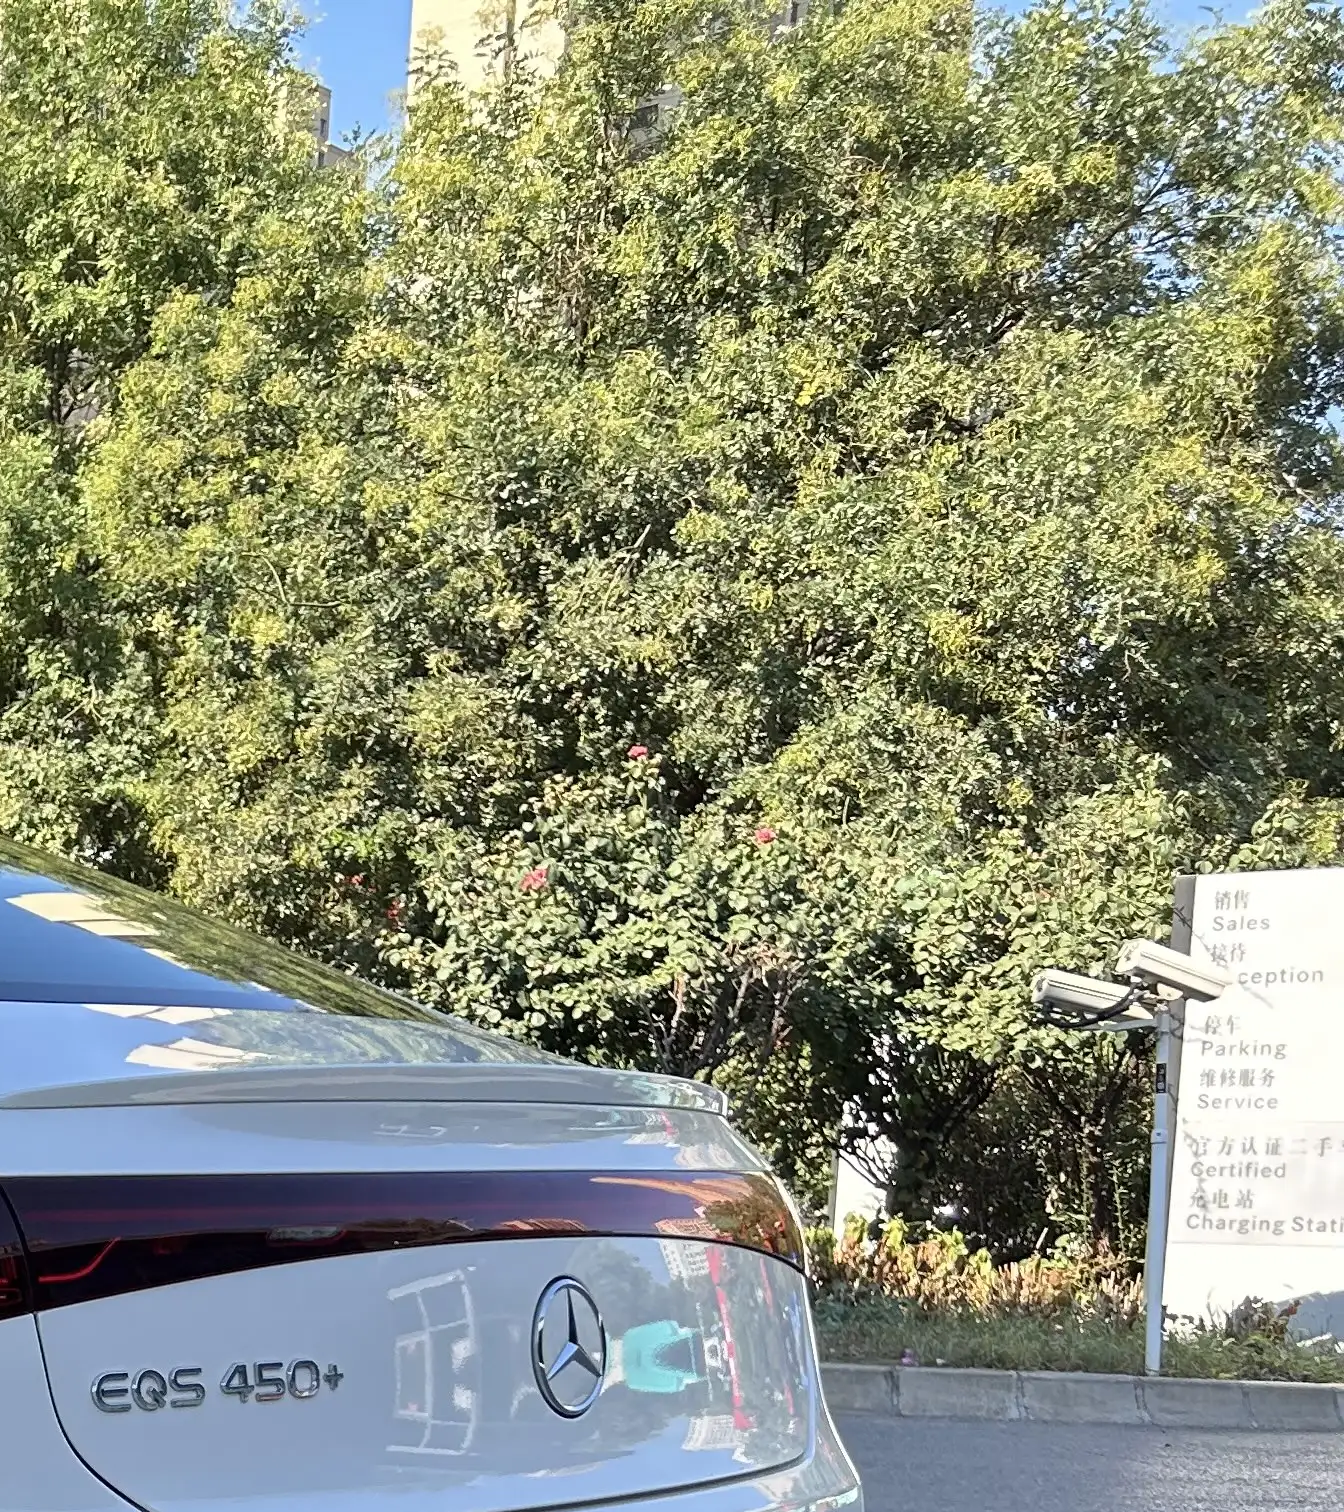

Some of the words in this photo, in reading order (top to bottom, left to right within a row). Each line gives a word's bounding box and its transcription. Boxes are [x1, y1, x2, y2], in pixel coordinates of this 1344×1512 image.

[1214, 889, 1250, 911] 销售
[1212, 915, 1270, 932] Sales
[1237, 966, 1324, 988] ception
[1201, 1039, 1287, 1060] Parking
[1199, 1067, 1276, 1088] 维修服务
[1197, 1093, 1279, 1109] Service
[1191, 1161, 1287, 1179] Certified
[1189, 1188, 1255, 1210] 充电站
[1186, 1213, 1285, 1236] Charging
[91, 1366, 206, 1413] EQS
[219, 1357, 344, 1403] 450+
